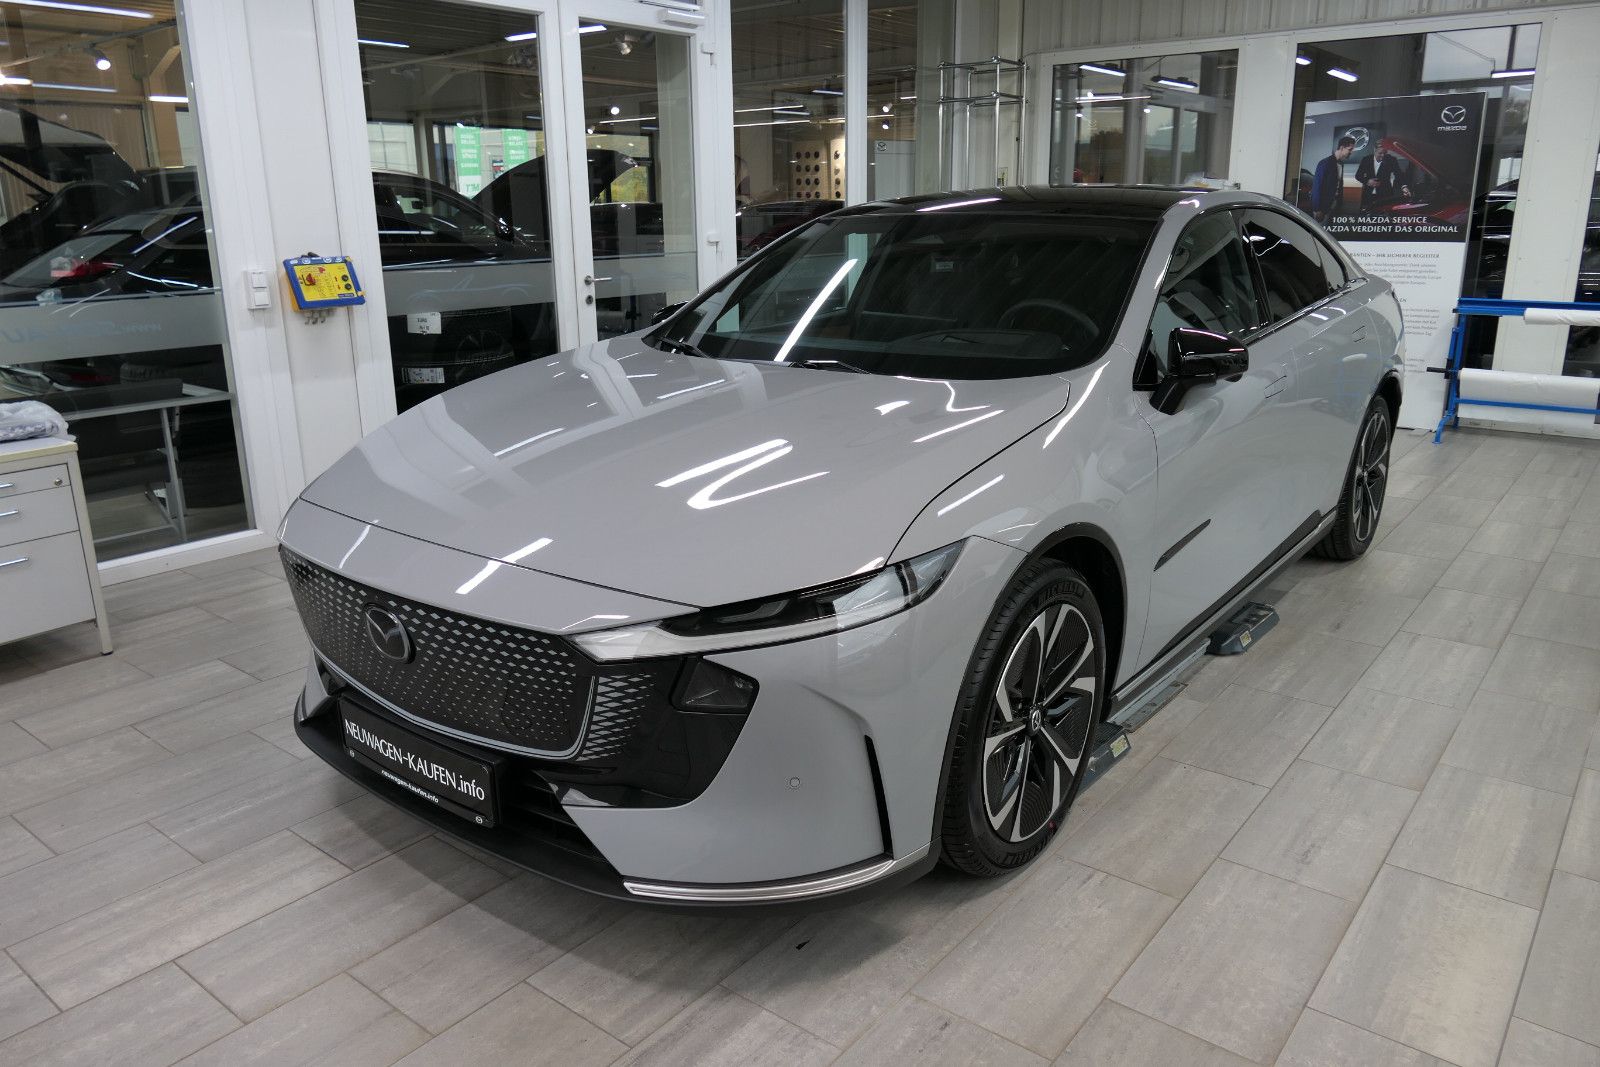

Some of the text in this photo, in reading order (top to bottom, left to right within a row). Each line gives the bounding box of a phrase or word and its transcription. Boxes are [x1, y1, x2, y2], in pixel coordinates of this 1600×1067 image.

[1332, 216, 1428, 224] 100 % MAZDA SERVICE
[1352, 225, 1393, 233] VERDIENT
[1394, 225, 1413, 233] DAS
[1414, 225, 1459, 233] ORIGINAL
[344, 718, 485, 801] NEUWAGEN-KAUFEN.info
